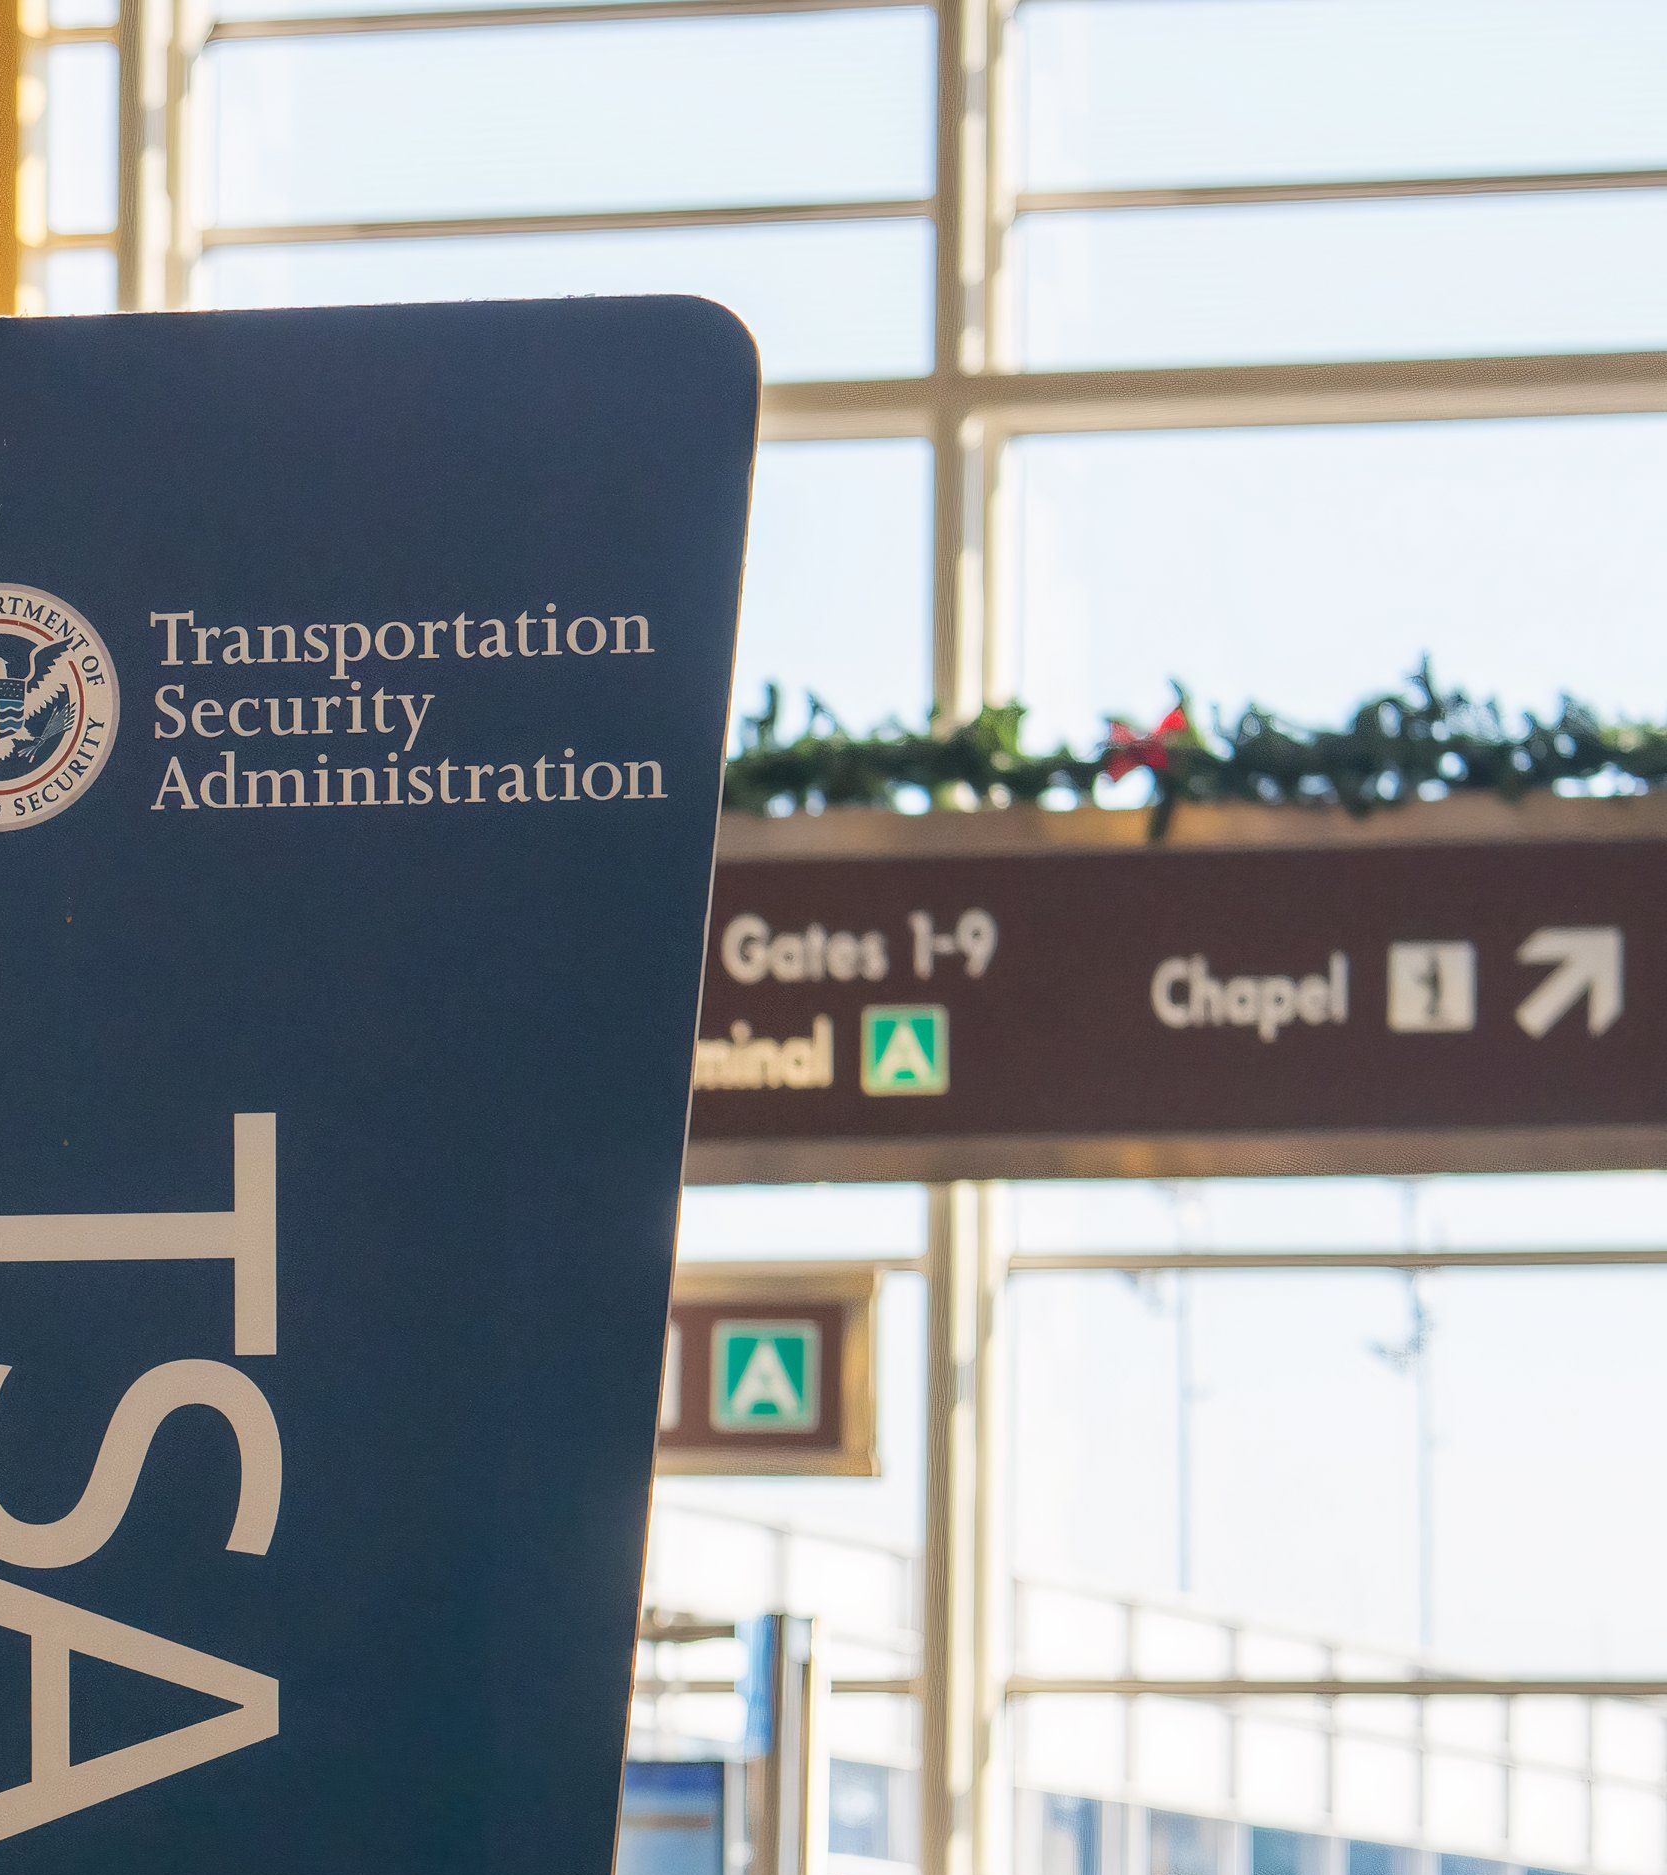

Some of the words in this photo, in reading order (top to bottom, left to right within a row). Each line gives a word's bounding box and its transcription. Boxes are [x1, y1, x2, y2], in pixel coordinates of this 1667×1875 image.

[81, 655, 106, 688] OF
[150, 602, 656, 680] Transportation
[153, 680, 436, 752] Security
[14, 716, 106, 817] SECURITY
[150, 747, 669, 811] Administration
[721, 912, 890, 985] Gates
[908, 907, 998, 980] 1-9
[1150, 950, 1351, 1044] Chapel
[694, 1013, 835, 1090] minal
